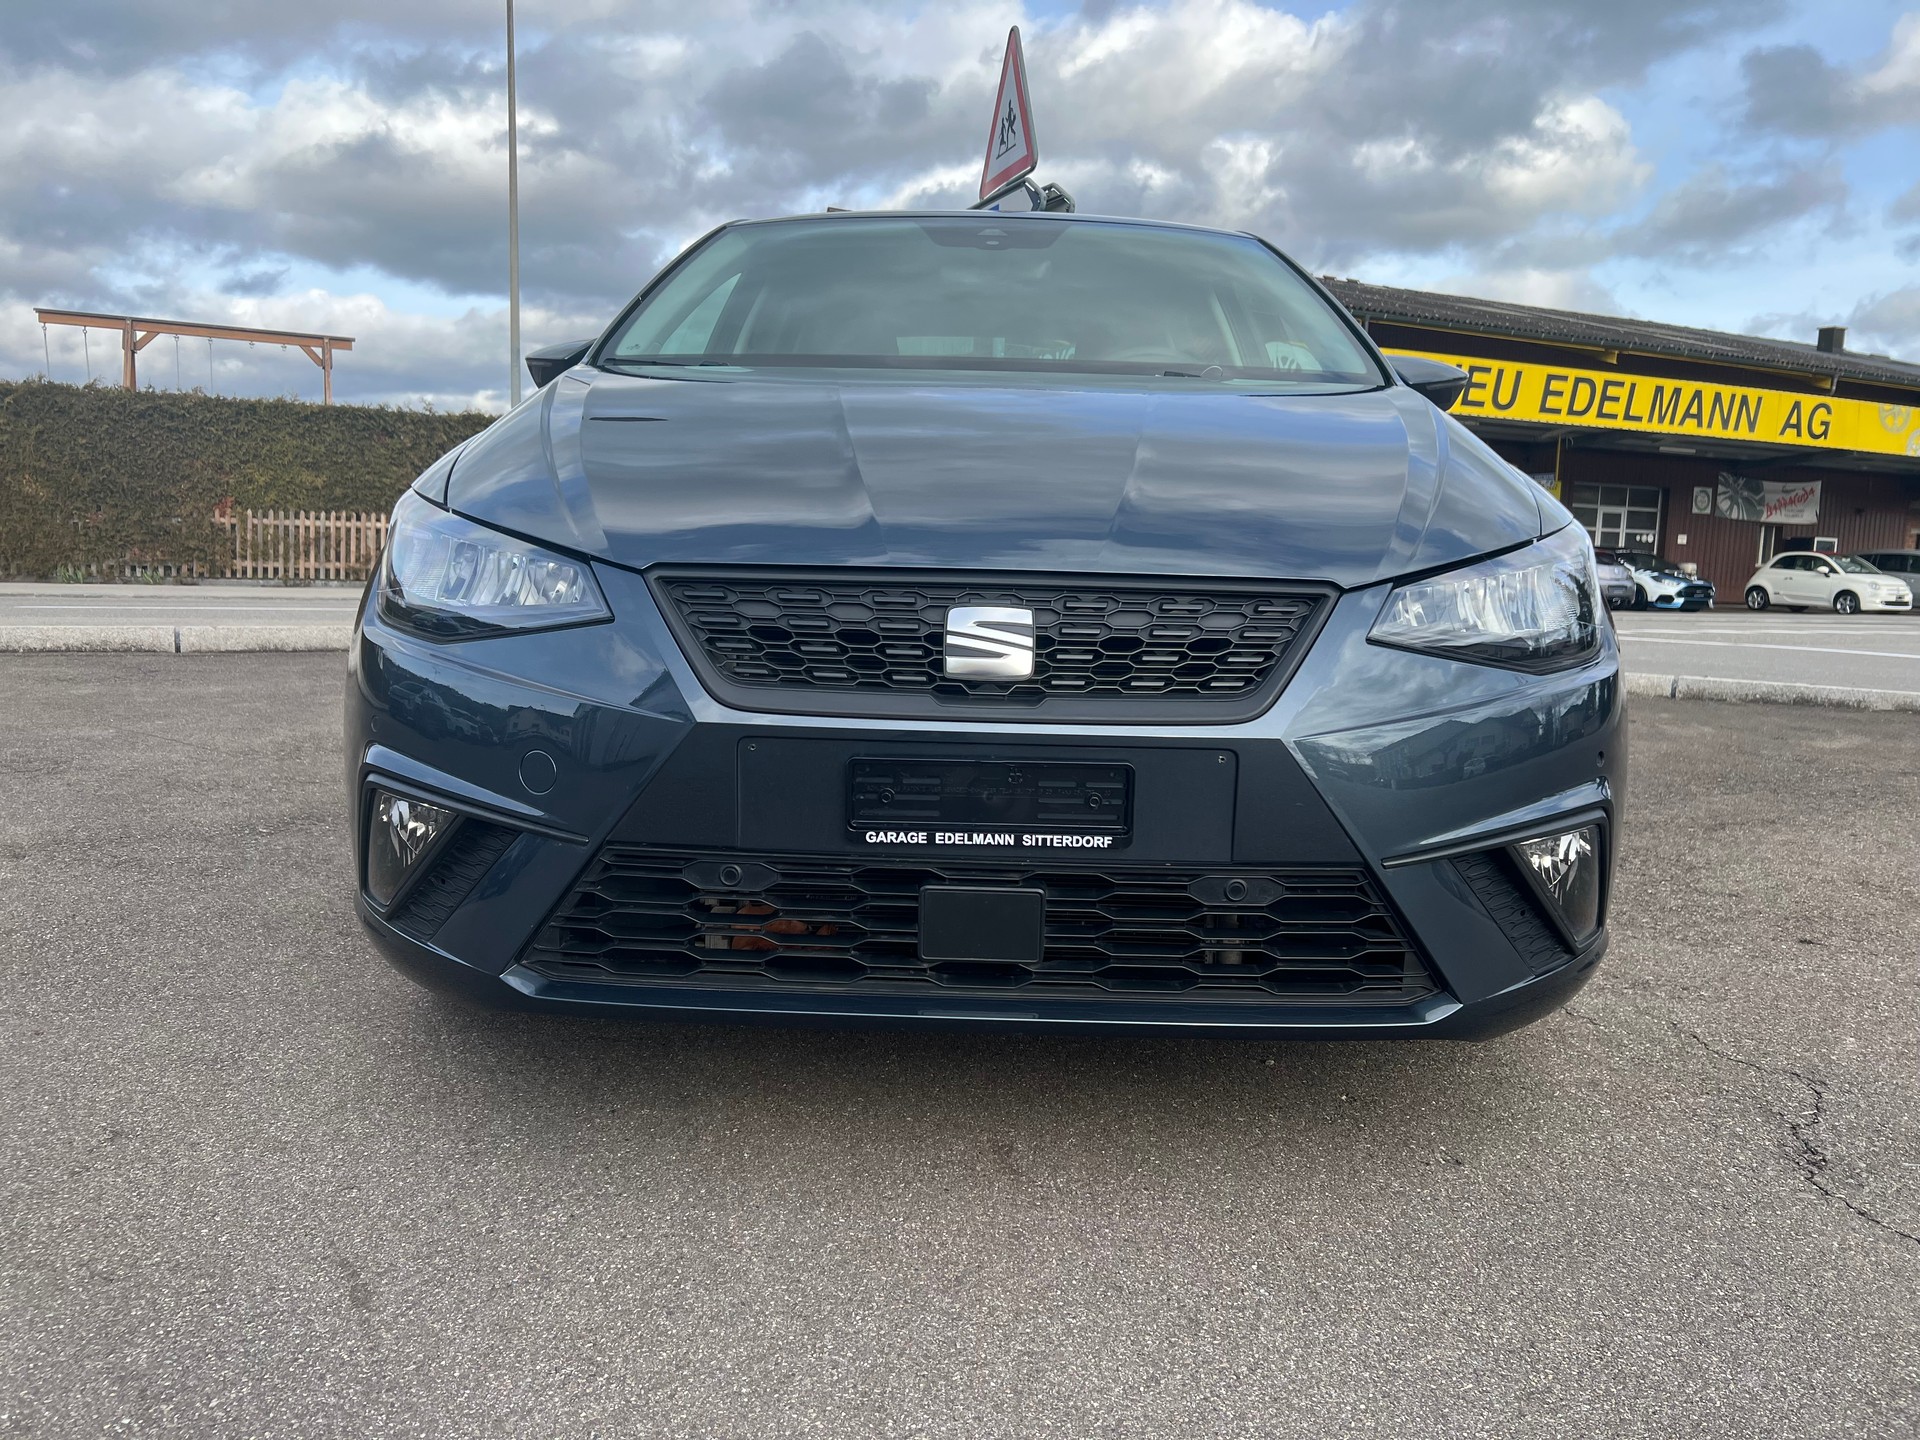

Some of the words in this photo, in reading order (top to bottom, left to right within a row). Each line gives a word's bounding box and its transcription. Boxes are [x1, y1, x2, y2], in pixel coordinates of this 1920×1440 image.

[1457, 364, 1523, 411] EU
[1538, 374, 1763, 434] EDELMANN
[1779, 400, 1833, 440] AG
[865, 831, 928, 844] GARAGE
[935, 832, 1015, 846] EDELMANN
[1021, 834, 1113, 848] SITTERDORF
